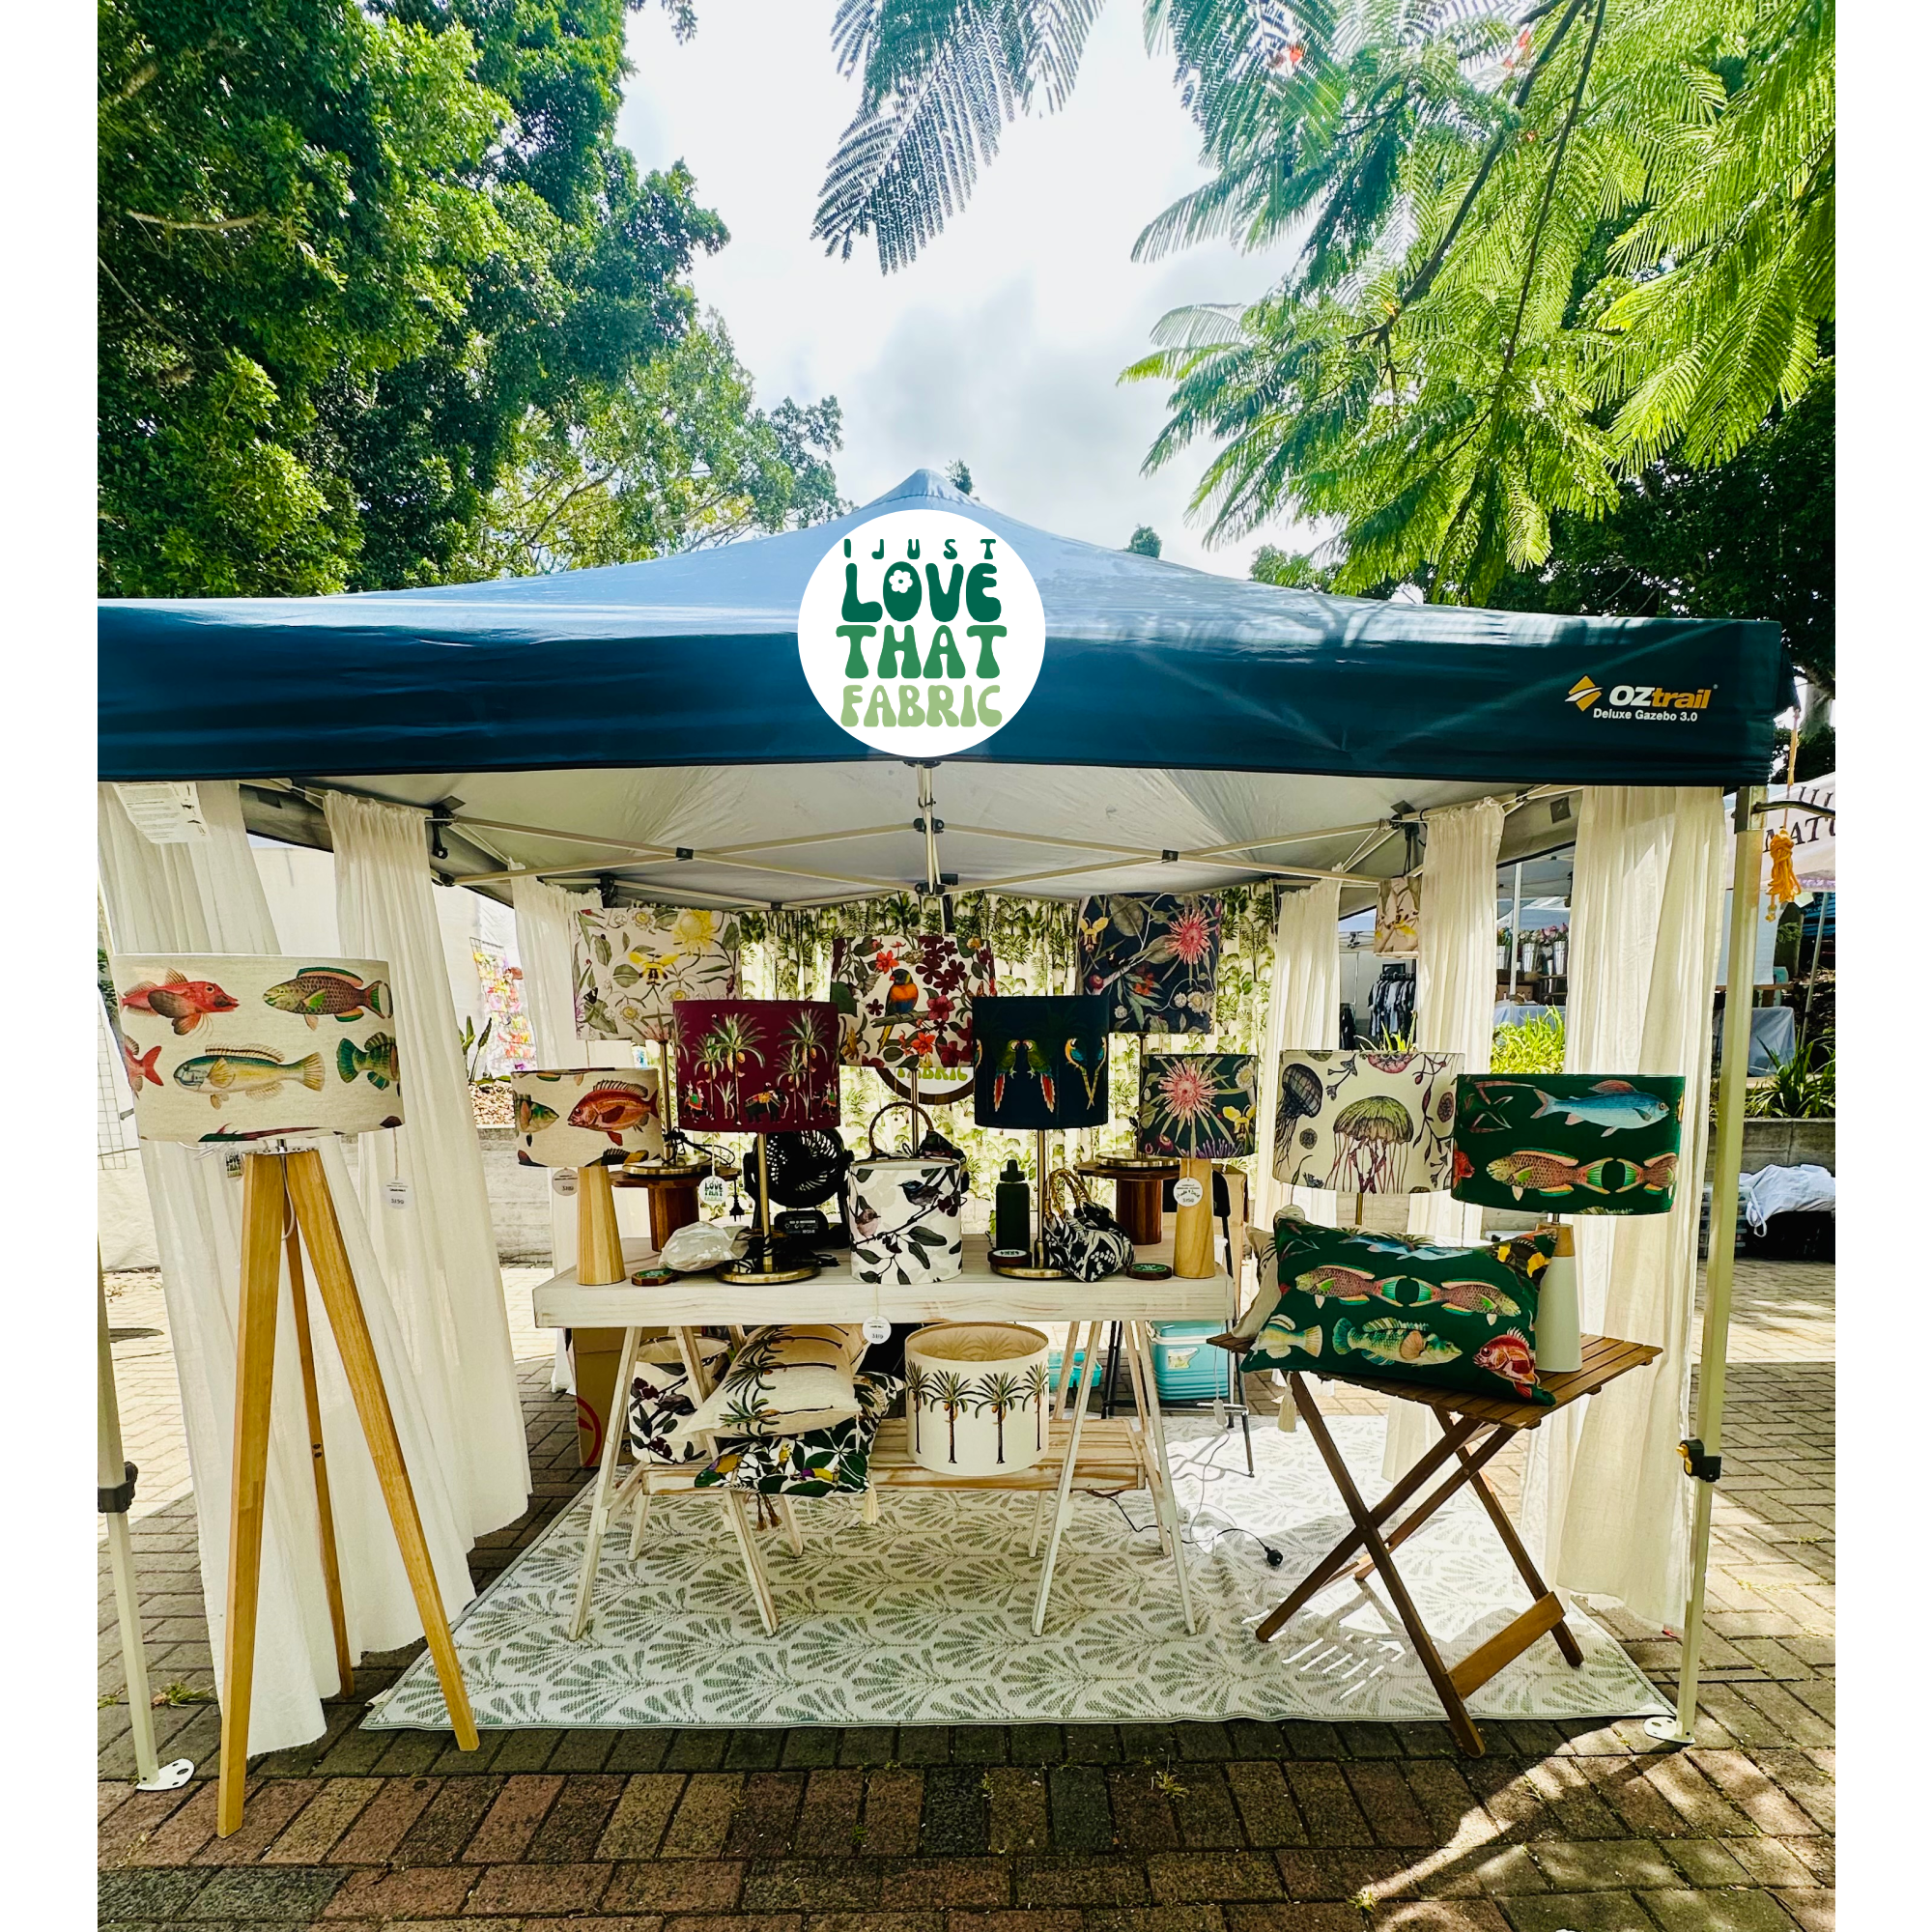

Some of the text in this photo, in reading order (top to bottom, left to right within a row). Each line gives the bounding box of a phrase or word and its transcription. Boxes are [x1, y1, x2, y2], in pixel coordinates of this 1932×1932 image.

[1608, 685, 1712, 709] OZtrail
[1593, 708, 1698, 722] Deluxe Gazebo 3.0
